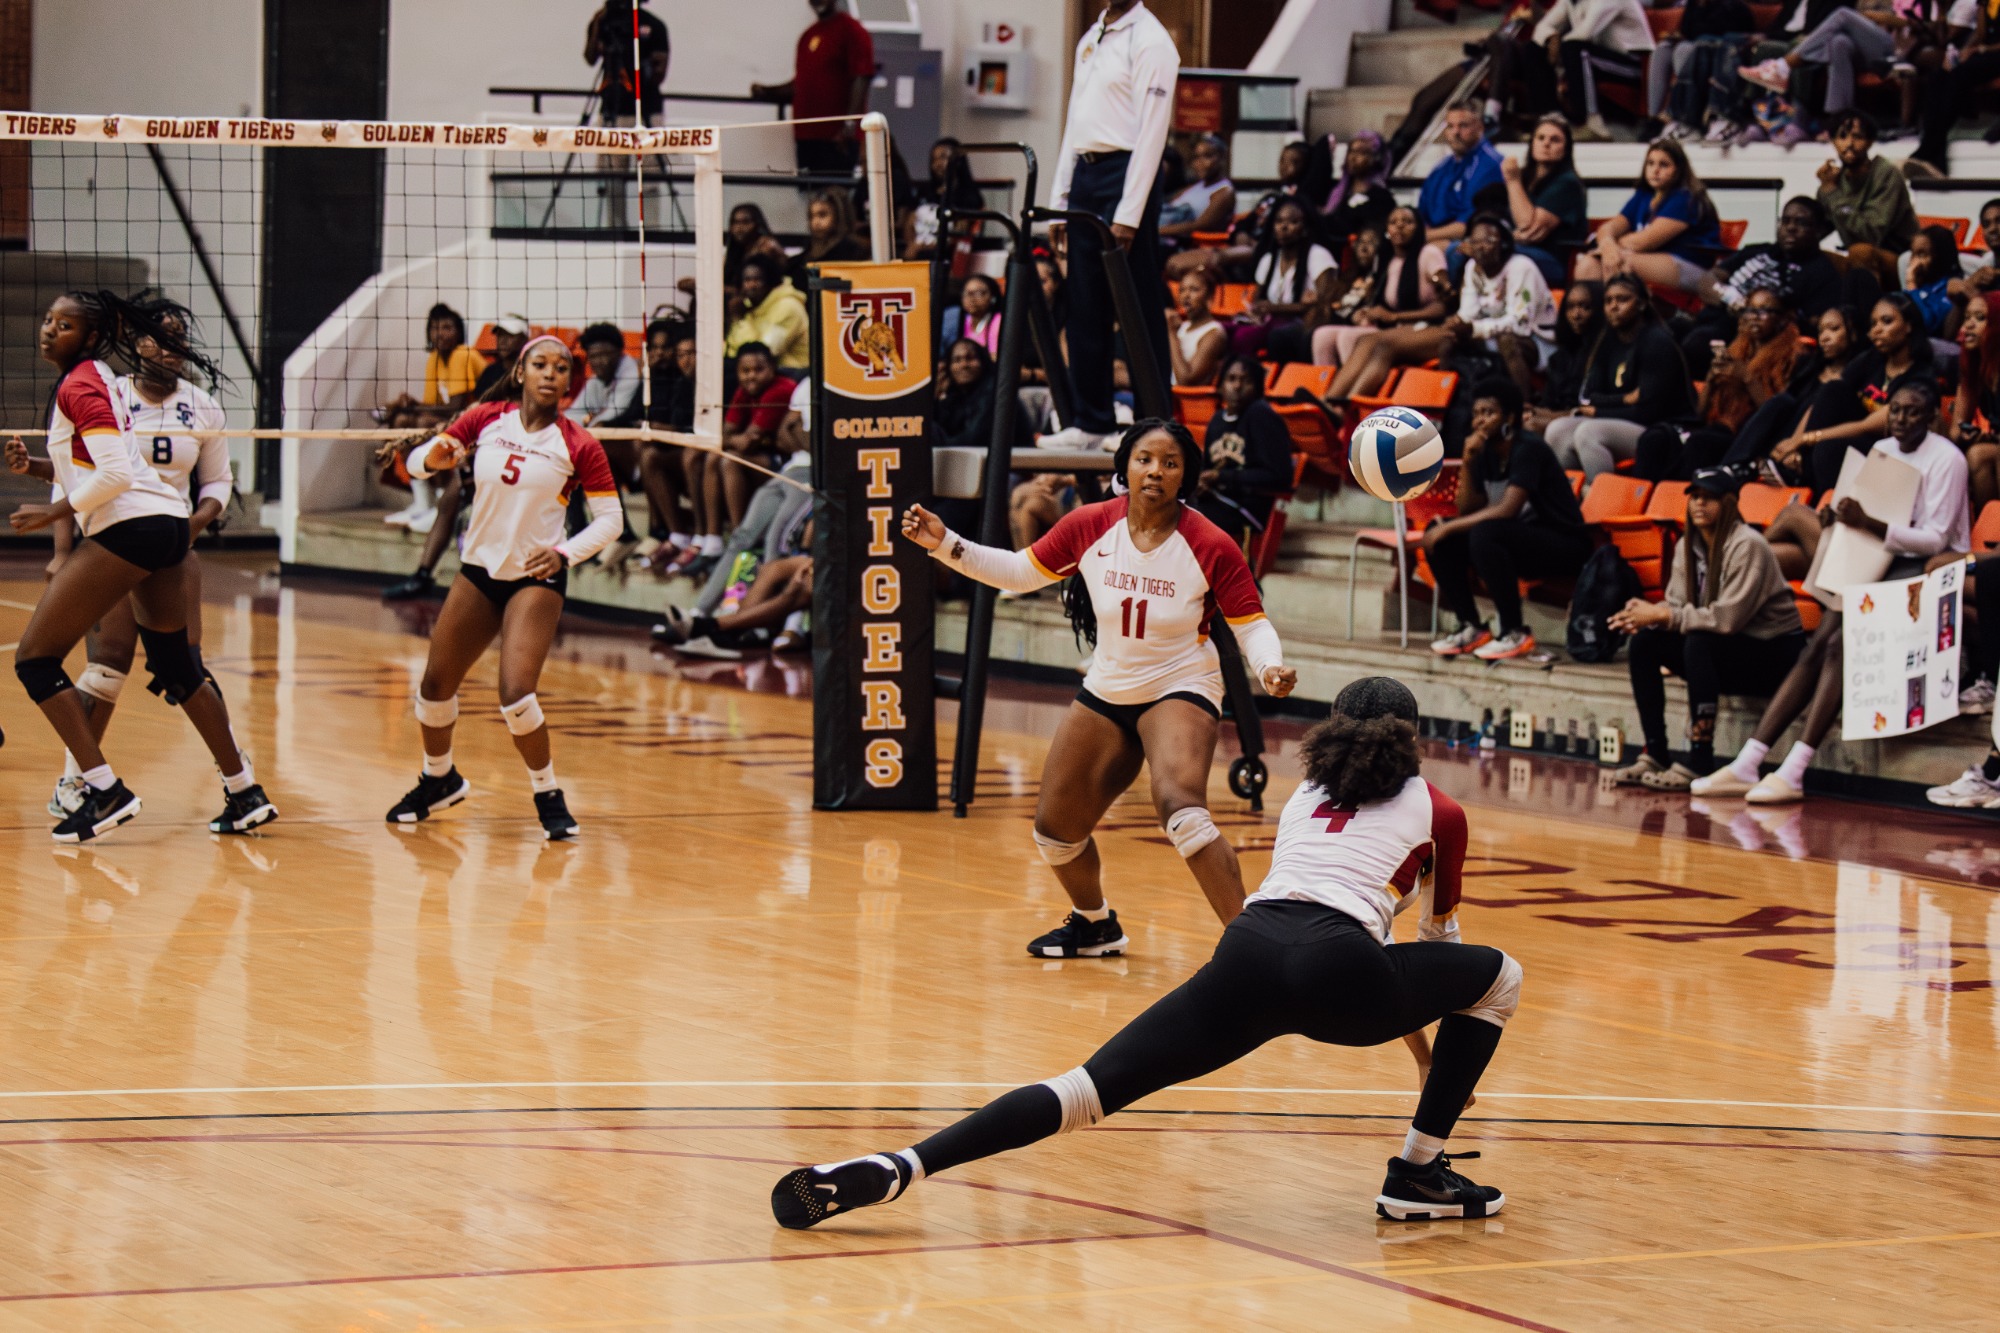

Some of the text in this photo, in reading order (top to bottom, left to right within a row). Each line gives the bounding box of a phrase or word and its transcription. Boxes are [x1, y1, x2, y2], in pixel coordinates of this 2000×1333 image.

[6, 115, 77, 136] TIGERS
[146, 120, 295, 140] GOLDEN TIGERS
[363, 124, 507, 145] GOLDEN TIGERS
[574, 127, 714, 149] GOLDEN TIGERS
[833, 415, 924, 439] GOLDEN
[152, 436, 173, 464] 8
[500, 453, 527, 486] 5
[1104, 569, 1176, 598] GOLDEN TIGERS
[857, 448, 906, 788] TIGERS
[1120, 596, 1148, 640] 11
